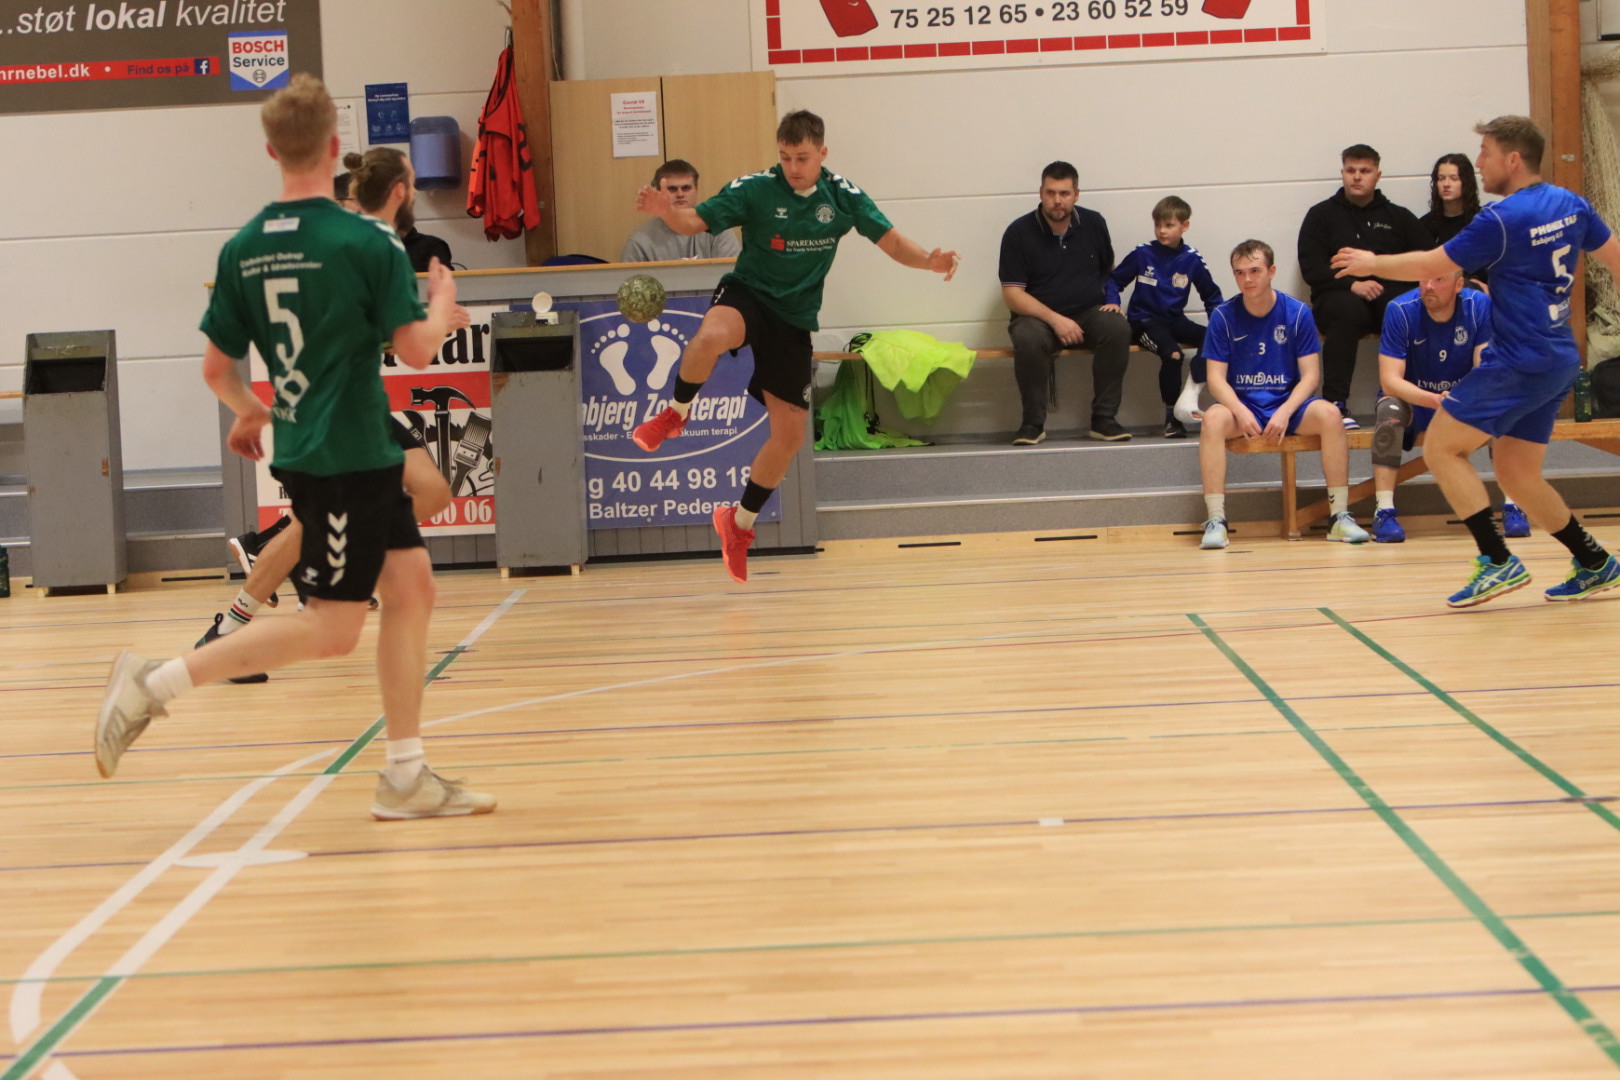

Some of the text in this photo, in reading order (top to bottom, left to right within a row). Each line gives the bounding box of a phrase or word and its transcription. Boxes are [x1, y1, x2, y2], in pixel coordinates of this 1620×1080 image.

[86, 1, 167, 31] lokal
[175, 0, 286, 27] kvalitet
[890, 0, 1189, 28] 75 25 12 65 23 60 52 59
[232, 40, 285, 54] BOSCH
[233, 55, 285, 68] Service
[127, 65, 154, 75] Find
[157, 66, 171, 74] os
[175, 63, 189, 77] på
[786, 237, 836, 247] SPAREKASSEN
[1551, 244, 1575, 294] 5
[263, 277, 305, 371] 5
[1258, 342, 1266, 355] 3
[1438, 349, 1448, 362] 9
[1236, 371, 1288, 386] LYNDAHL
[711, 427, 738, 437] terapi
[611, 471, 642, 492] 40
[650, 469, 680, 491] 44
[687, 468, 717, 489] 98
[726, 466, 752, 487] 18
[464, 499, 492, 523] 06
[589, 503, 658, 519] Baltzer
